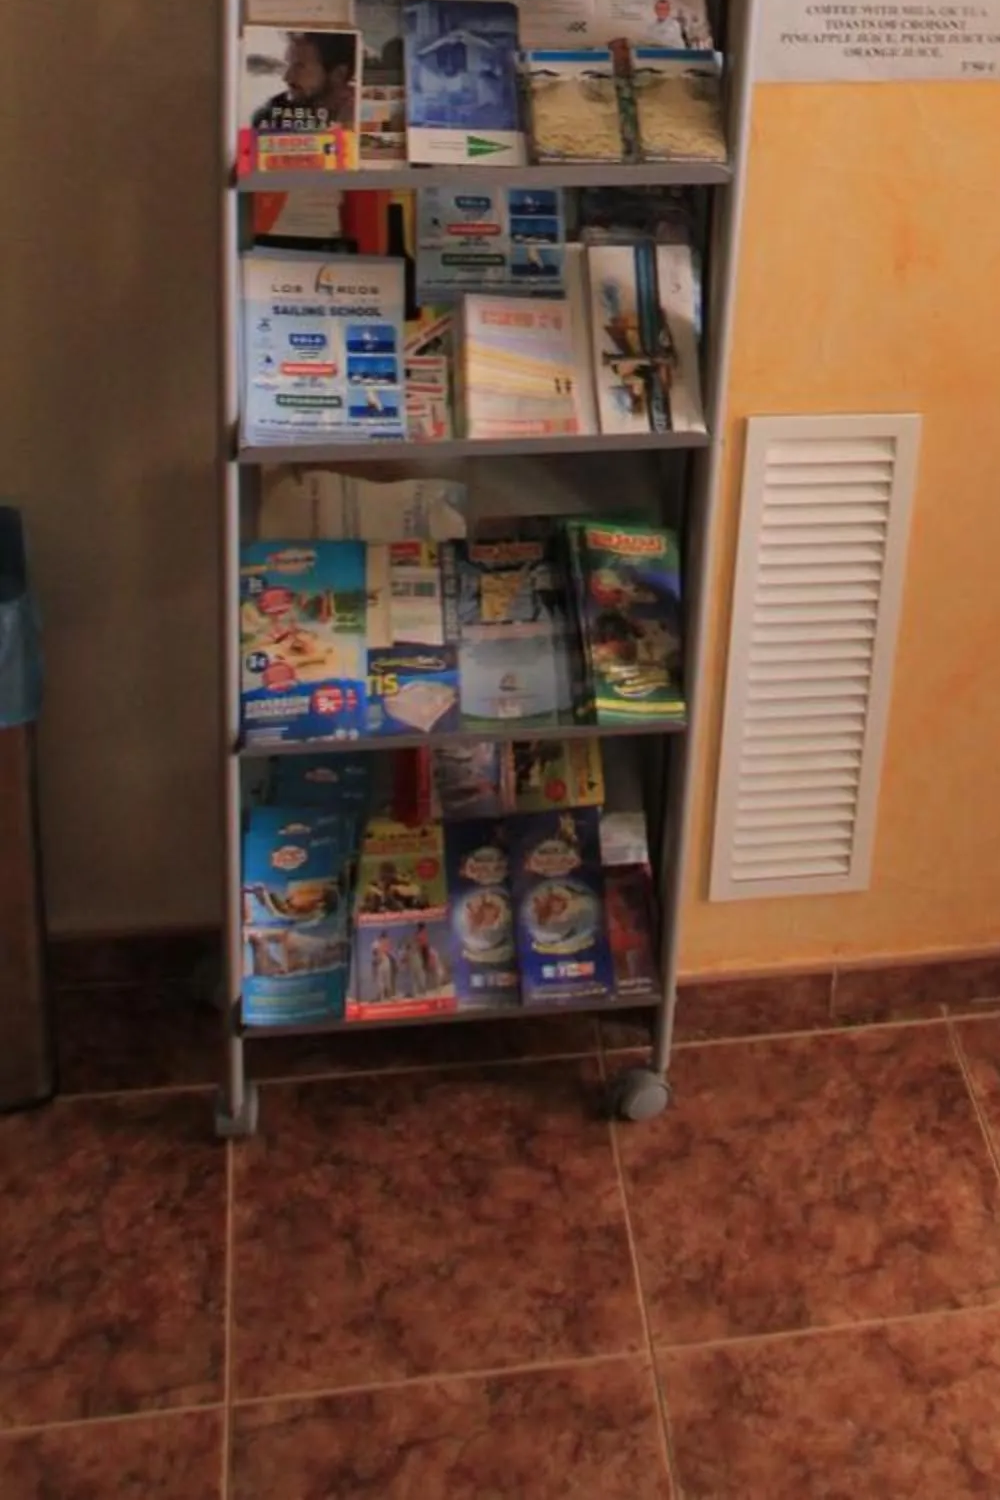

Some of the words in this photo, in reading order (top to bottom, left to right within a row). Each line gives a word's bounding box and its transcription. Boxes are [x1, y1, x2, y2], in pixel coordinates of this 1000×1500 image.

[862, 5, 898, 16] WITH
[271, 107, 329, 122] PABLO
[271, 284, 303, 293] LOS
[271, 305, 325, 317] SAILING
[329, 305, 382, 317] SCHOOL
